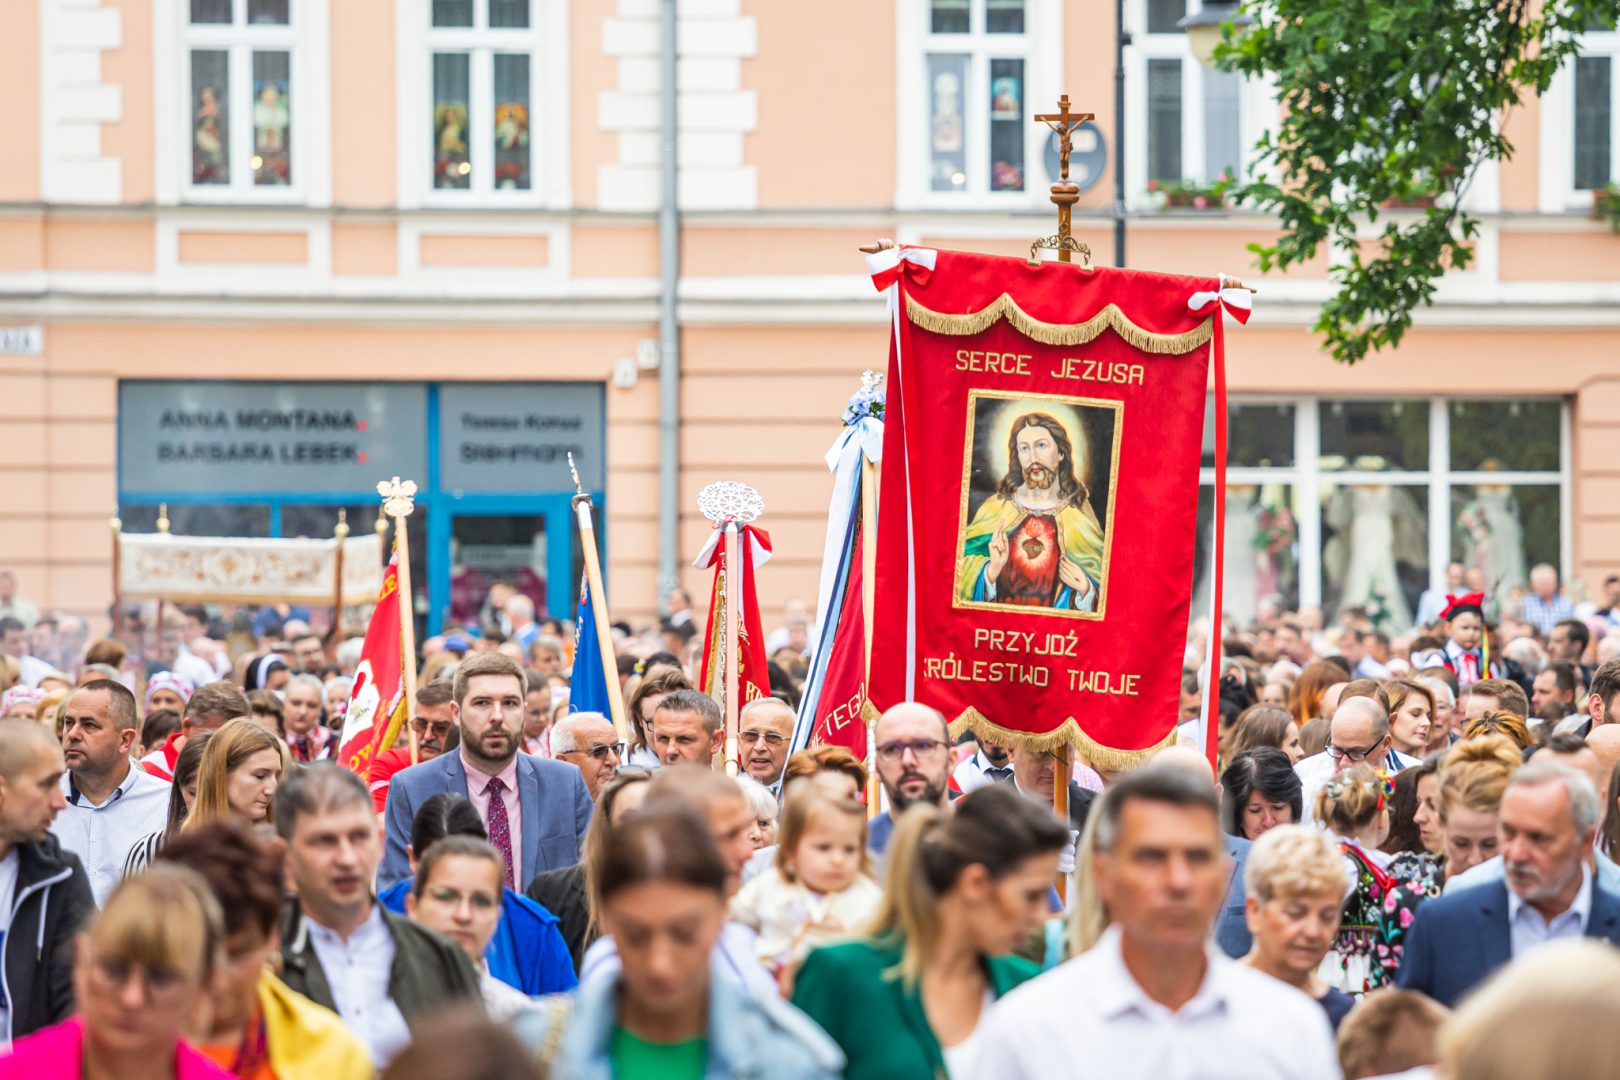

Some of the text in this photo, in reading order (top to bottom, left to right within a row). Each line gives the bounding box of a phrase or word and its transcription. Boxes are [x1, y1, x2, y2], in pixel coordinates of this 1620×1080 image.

[955, 350, 1145, 386] SERCE JEZUSA
[159, 409, 231, 429] ANNA
[156, 442, 277, 462] BARBARA
[974, 628, 1079, 657] PRZYJDŹ
[1067, 669, 1141, 695] TWOJE
